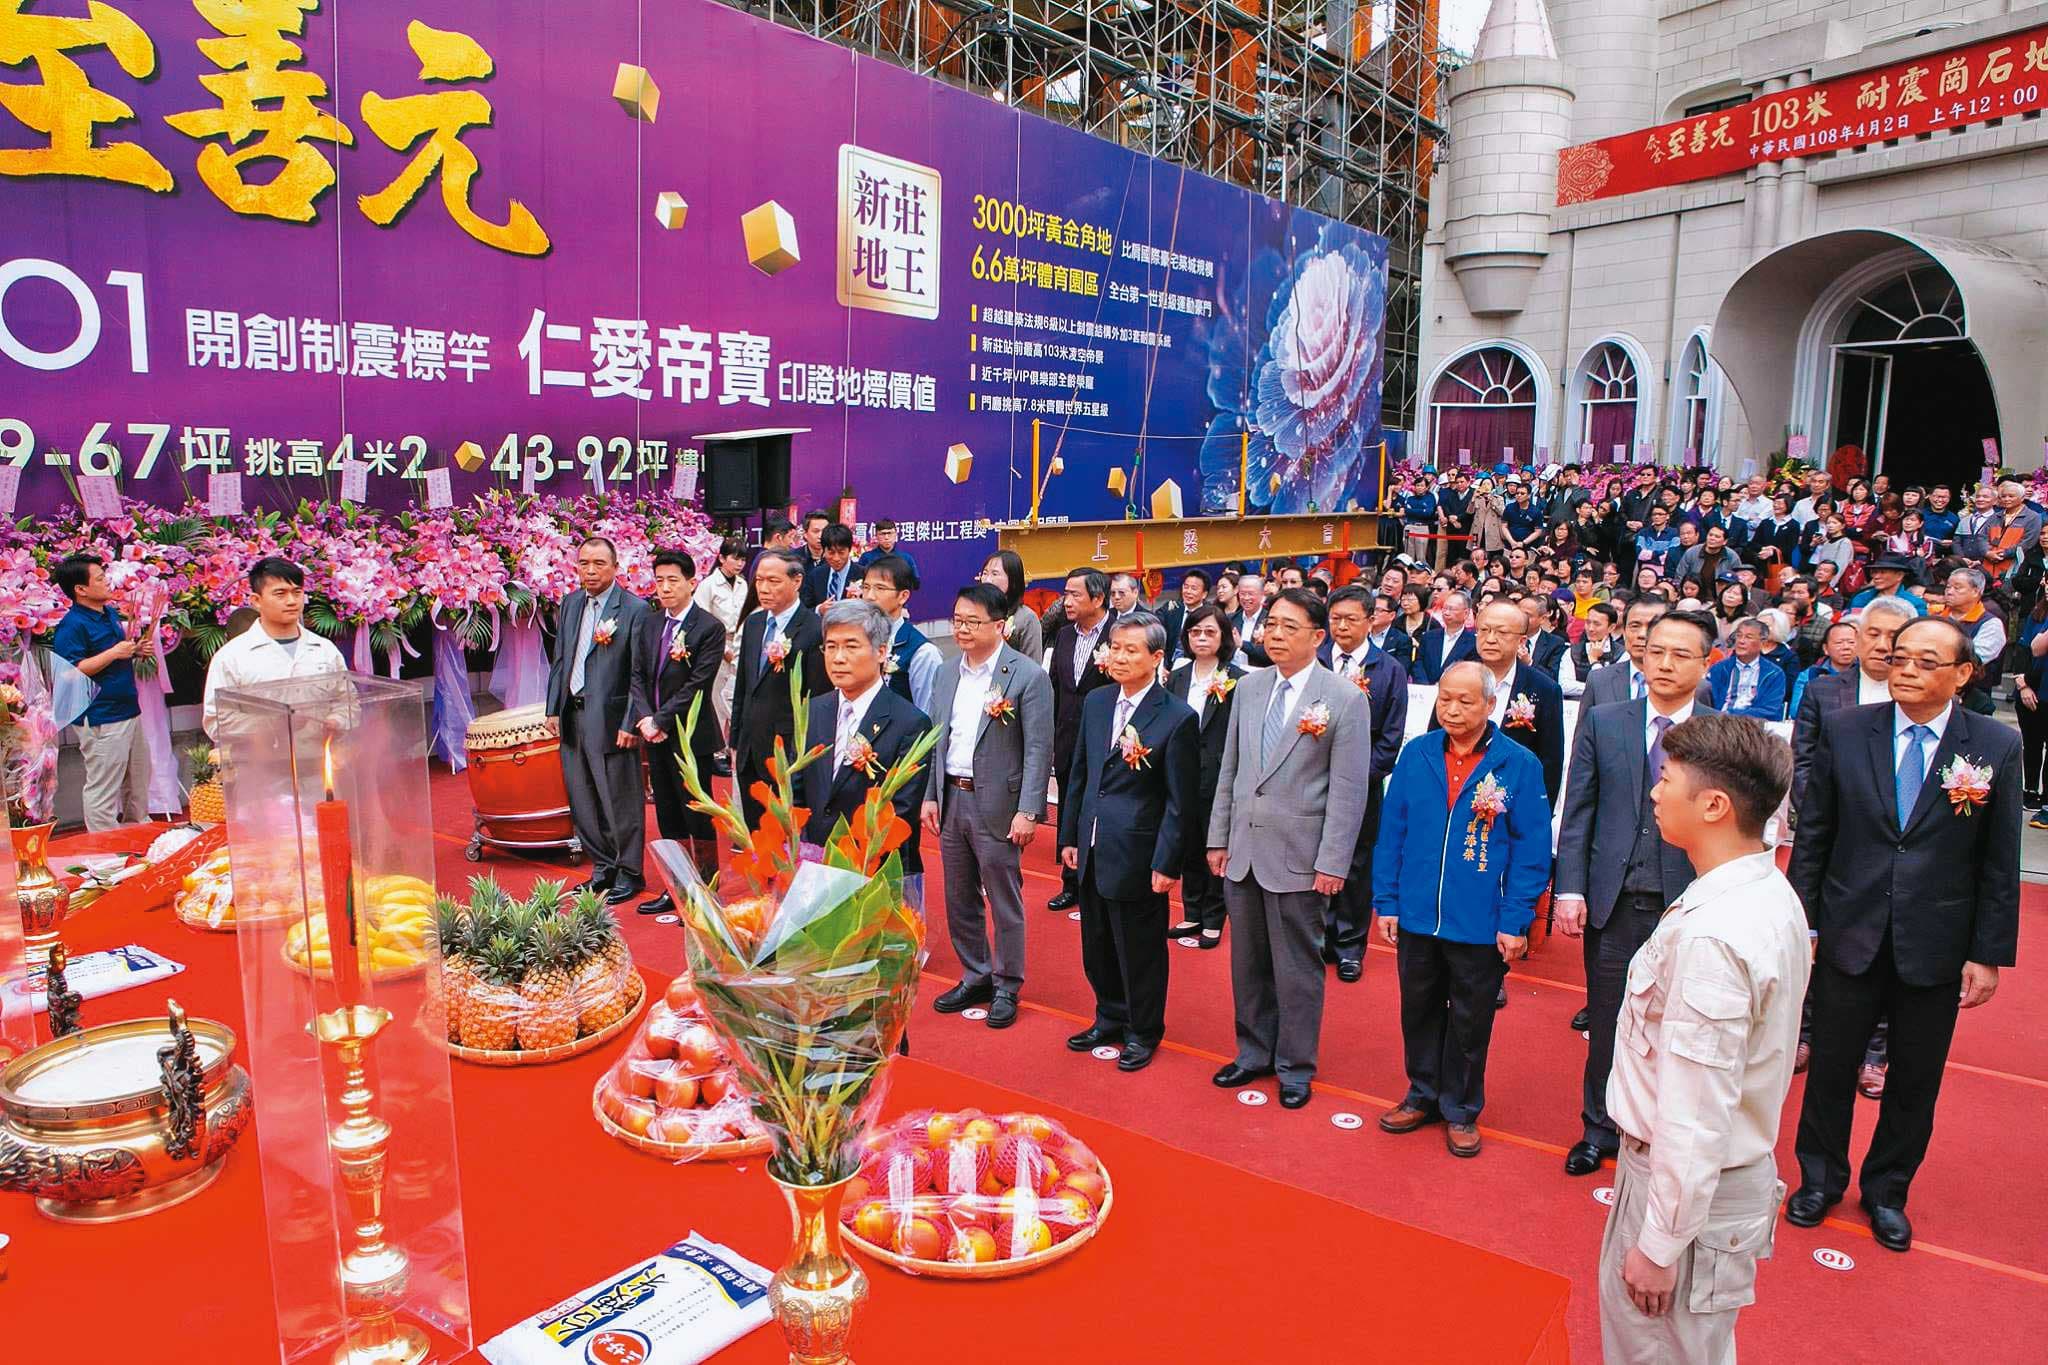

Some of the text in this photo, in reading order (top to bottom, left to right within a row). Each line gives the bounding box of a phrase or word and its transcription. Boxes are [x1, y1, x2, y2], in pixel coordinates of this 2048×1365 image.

[0, 0, 549, 255] 至善元
[1667, 115, 1735, 161] 至善元
[1748, 91, 1832, 139] 103米
[1749, 113, 1910, 160] 中華民國108年4月2日
[853, 169, 928, 237] 新莊
[972, 194, 1113, 256] 3000坪黃金角地
[852, 235, 926, 297] 地王
[971, 244, 1099, 297] 6.6萬坪體育園區
[185, 307, 491, 383] 開創制震標竿
[518, 308, 771, 408] 仁愛帝寶
[778, 360, 937, 412] 印證地標價值
[490, 433, 669, 481] 43-92坪
